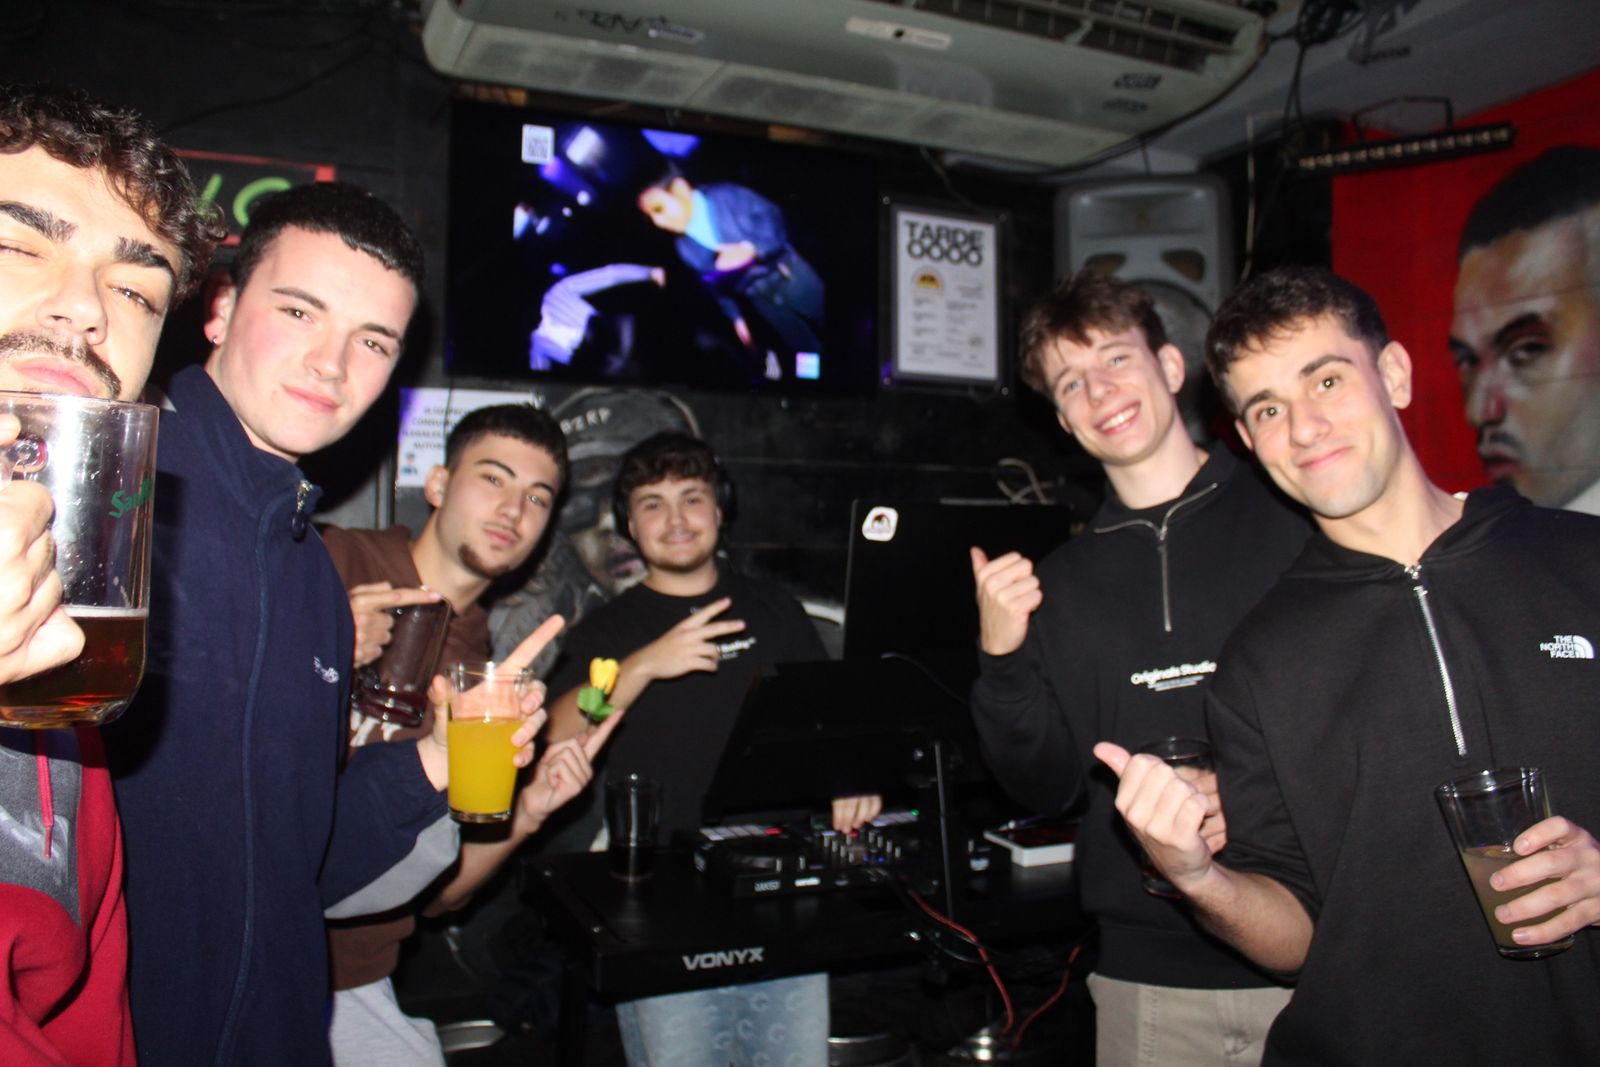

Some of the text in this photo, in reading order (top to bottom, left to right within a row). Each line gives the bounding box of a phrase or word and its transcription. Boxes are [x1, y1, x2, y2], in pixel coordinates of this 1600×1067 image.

[905, 220, 984, 249] TARDE
[1553, 635, 1573, 643] THE
[1540, 642, 1574, 651] NORTH
[1550, 650, 1576, 658] FACE
[682, 947, 764, 970] VONYX
